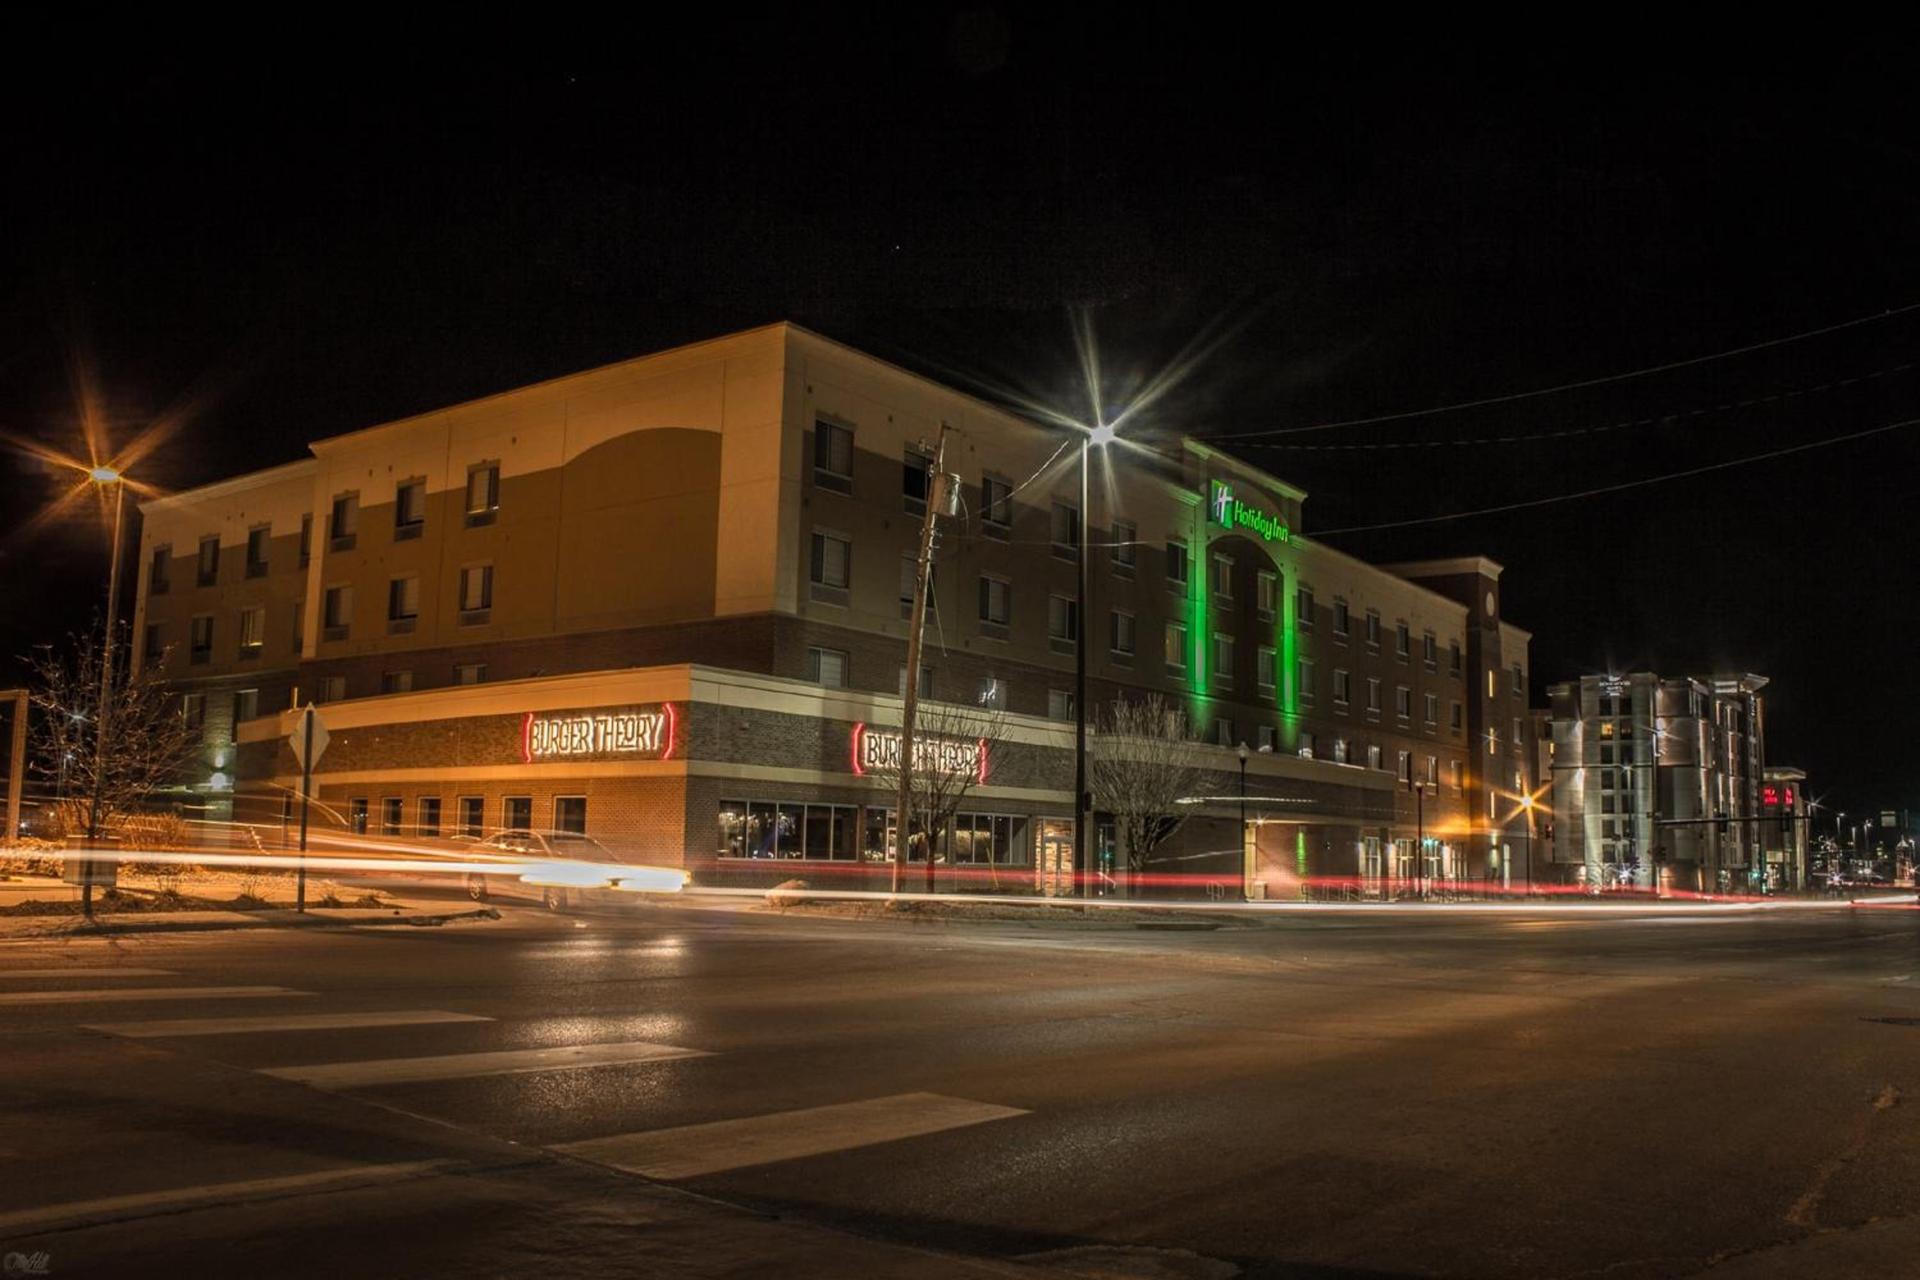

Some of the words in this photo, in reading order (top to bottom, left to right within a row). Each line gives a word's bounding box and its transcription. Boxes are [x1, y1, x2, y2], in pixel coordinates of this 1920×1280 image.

[1234, 500, 1273, 541] Holiday
[1273, 517, 1288, 543] Inn
[531, 717, 594, 755] BURGER
[595, 714, 665, 752] THEORY
[864, 732, 926, 771] BURR
